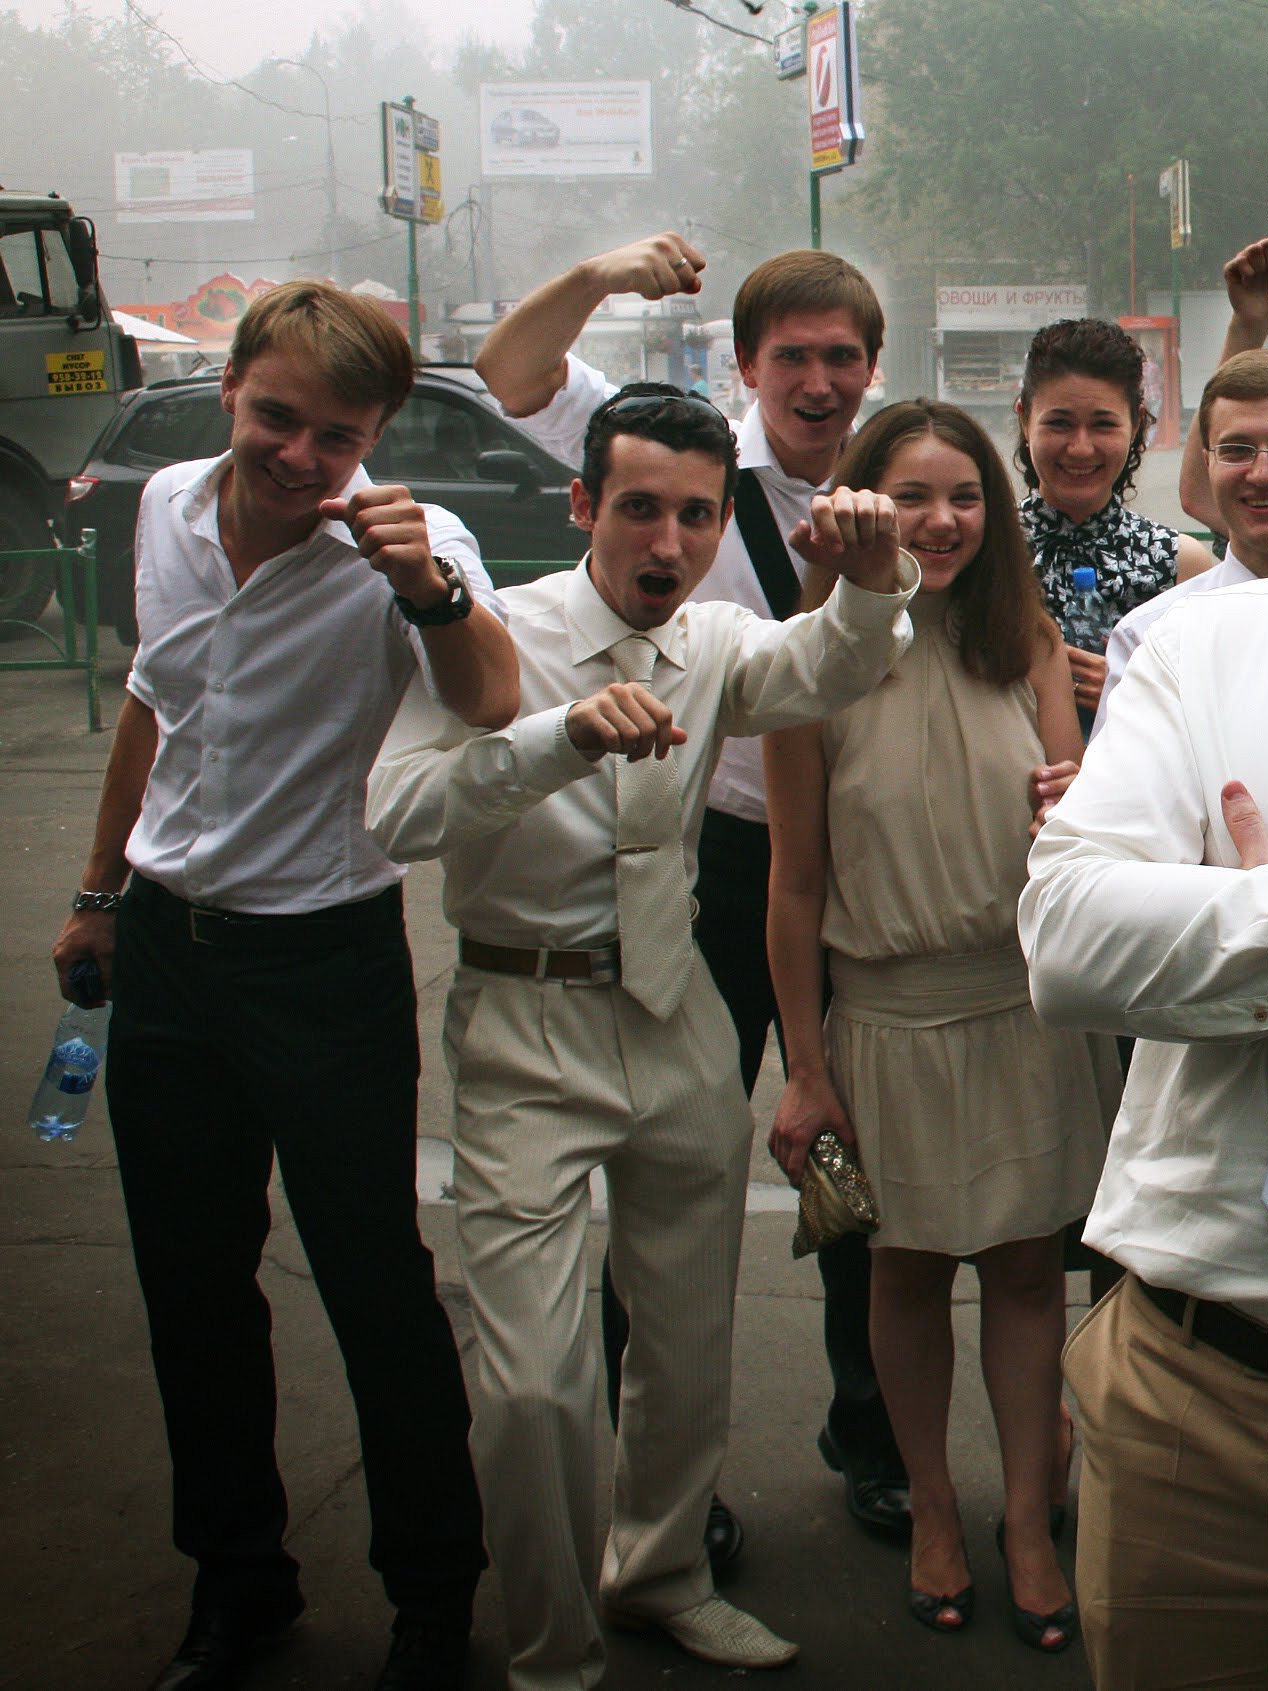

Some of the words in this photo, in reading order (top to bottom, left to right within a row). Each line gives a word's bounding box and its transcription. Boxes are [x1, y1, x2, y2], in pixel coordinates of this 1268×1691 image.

[939, 290, 997, 305] ОВОЩИ
[1006, 290, 1017, 305] И
[1023, 289, 1086, 305] ФРУКТЫ
[55, 382, 102, 392] ВЫВОЗ
